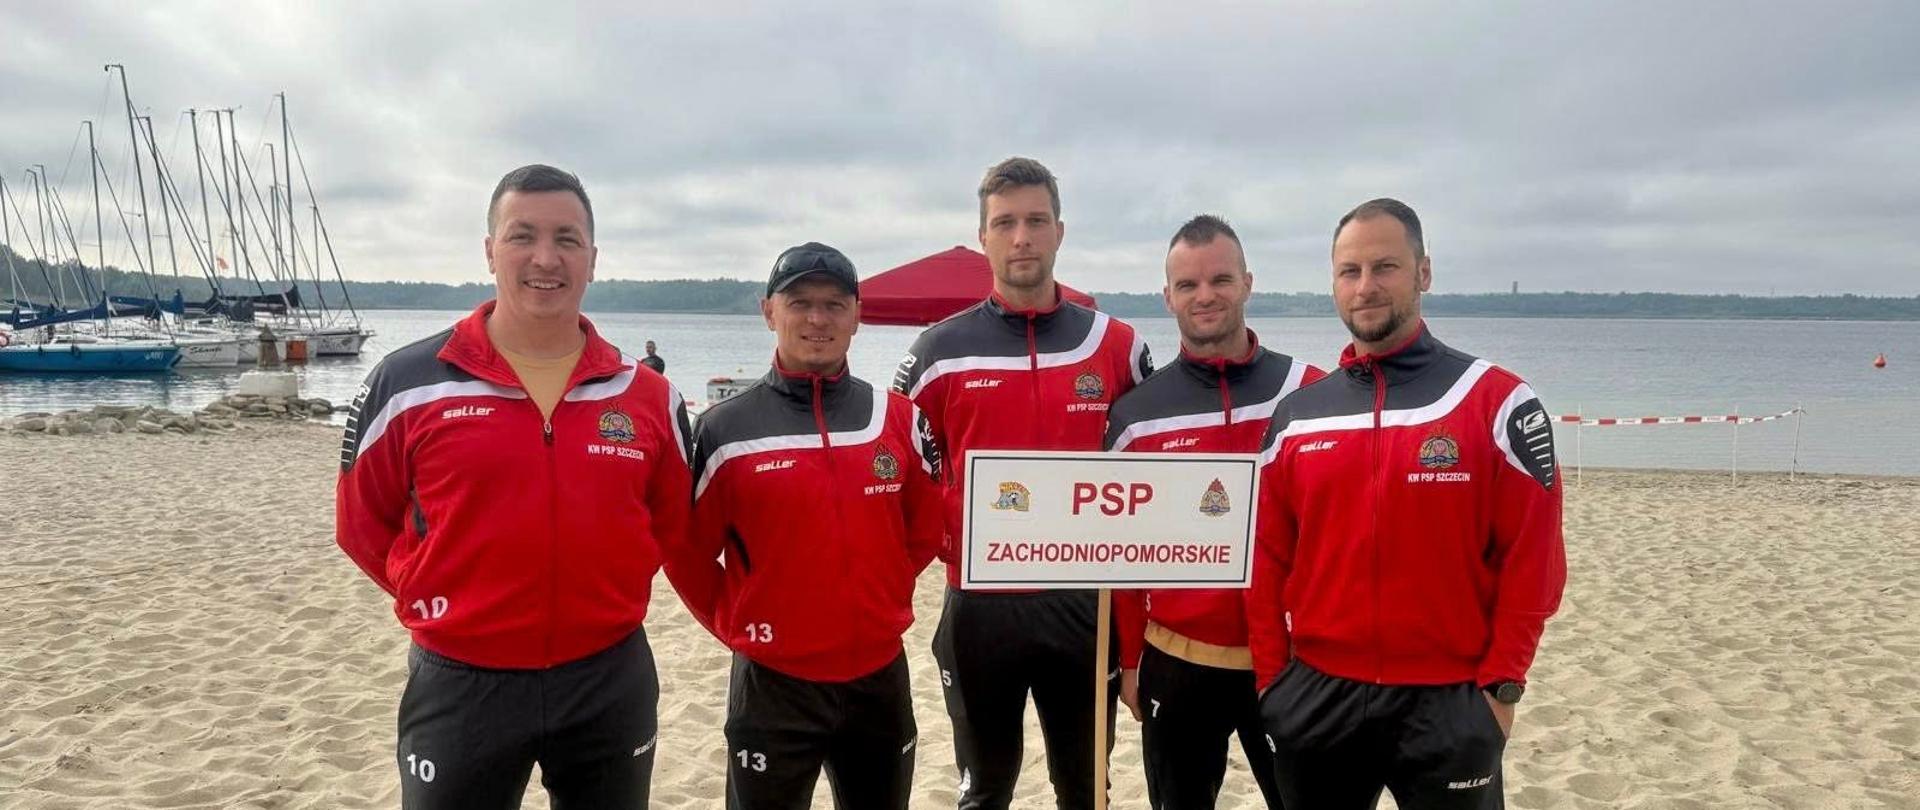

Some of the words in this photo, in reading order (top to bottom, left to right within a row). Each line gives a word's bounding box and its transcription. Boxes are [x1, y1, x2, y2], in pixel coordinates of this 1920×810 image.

[964, 379, 1004, 389] saller
[442, 405, 496, 419] saller
[601, 445, 616, 455] PSP
[1299, 441, 1338, 452] saller
[755, 460, 797, 472] saller
[1408, 473, 1419, 483] KW
[1421, 473, 1435, 482] PSP
[1436, 473, 1471, 482] SZCZECIN
[1072, 482, 1154, 516] PSP
[987, 543, 1231, 563] ZACHODNIOPOMORSKIE
[411, 596, 449, 620] 10
[745, 623, 773, 643] 13
[942, 669, 952, 687] 5
[1150, 698, 1160, 718] 7
[407, 754, 436, 782] 10
[736, 749, 767, 771] 13
[1448, 774, 1493, 789] saller
